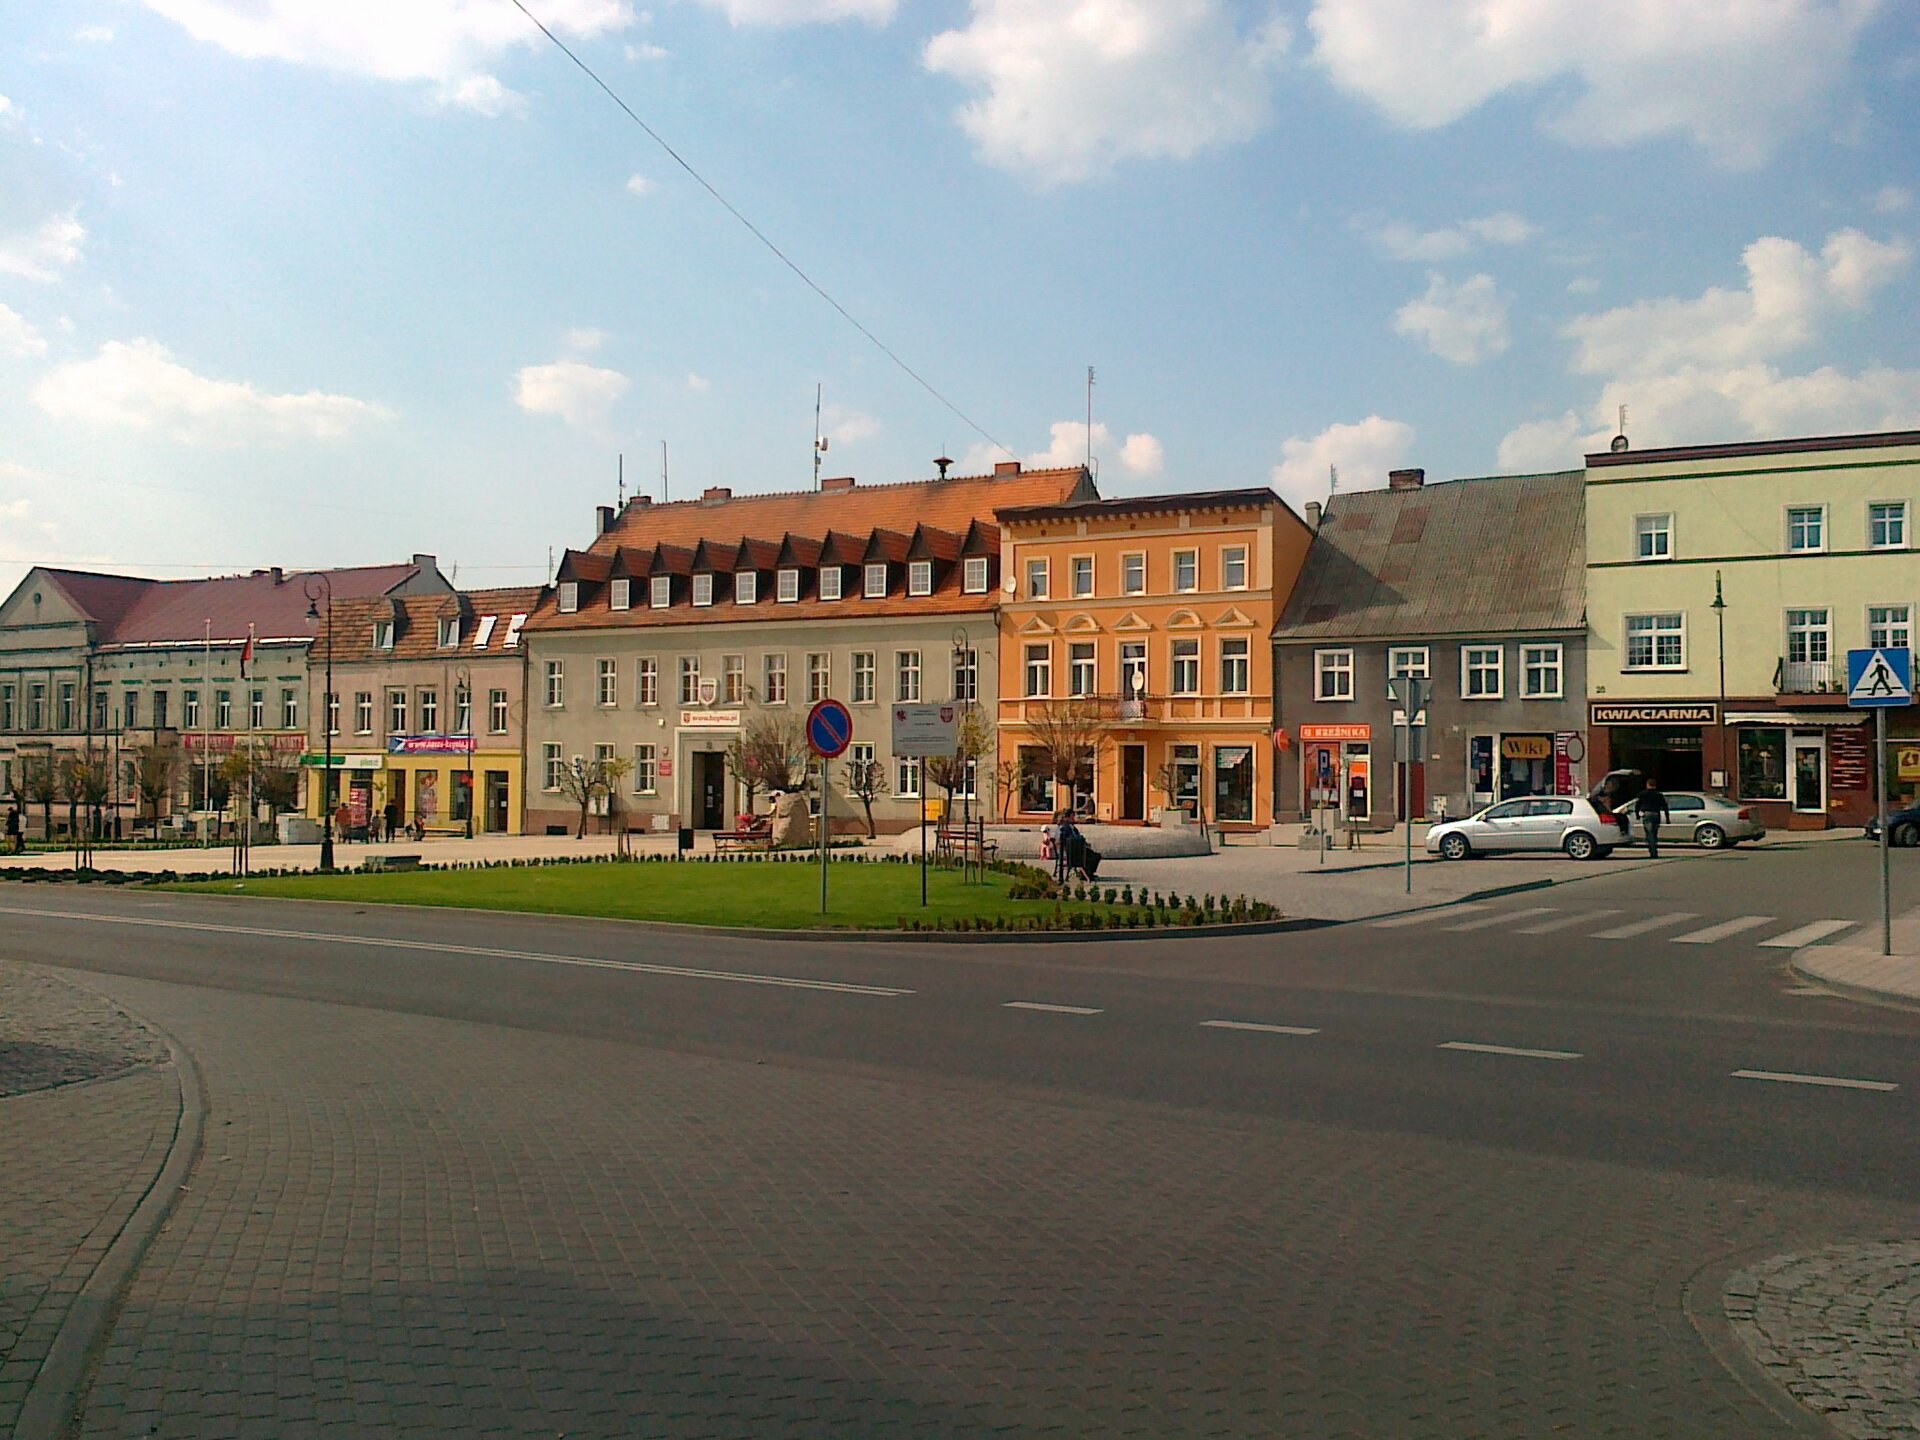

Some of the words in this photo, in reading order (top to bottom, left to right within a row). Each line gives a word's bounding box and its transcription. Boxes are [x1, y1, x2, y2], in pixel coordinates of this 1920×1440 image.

[1597, 709, 1711, 720] KWIACIARNIA
[1304, 728, 1311, 737] U
[1315, 726, 1366, 737] RZEŹNIKA
[1508, 741, 1543, 755] Wiki
